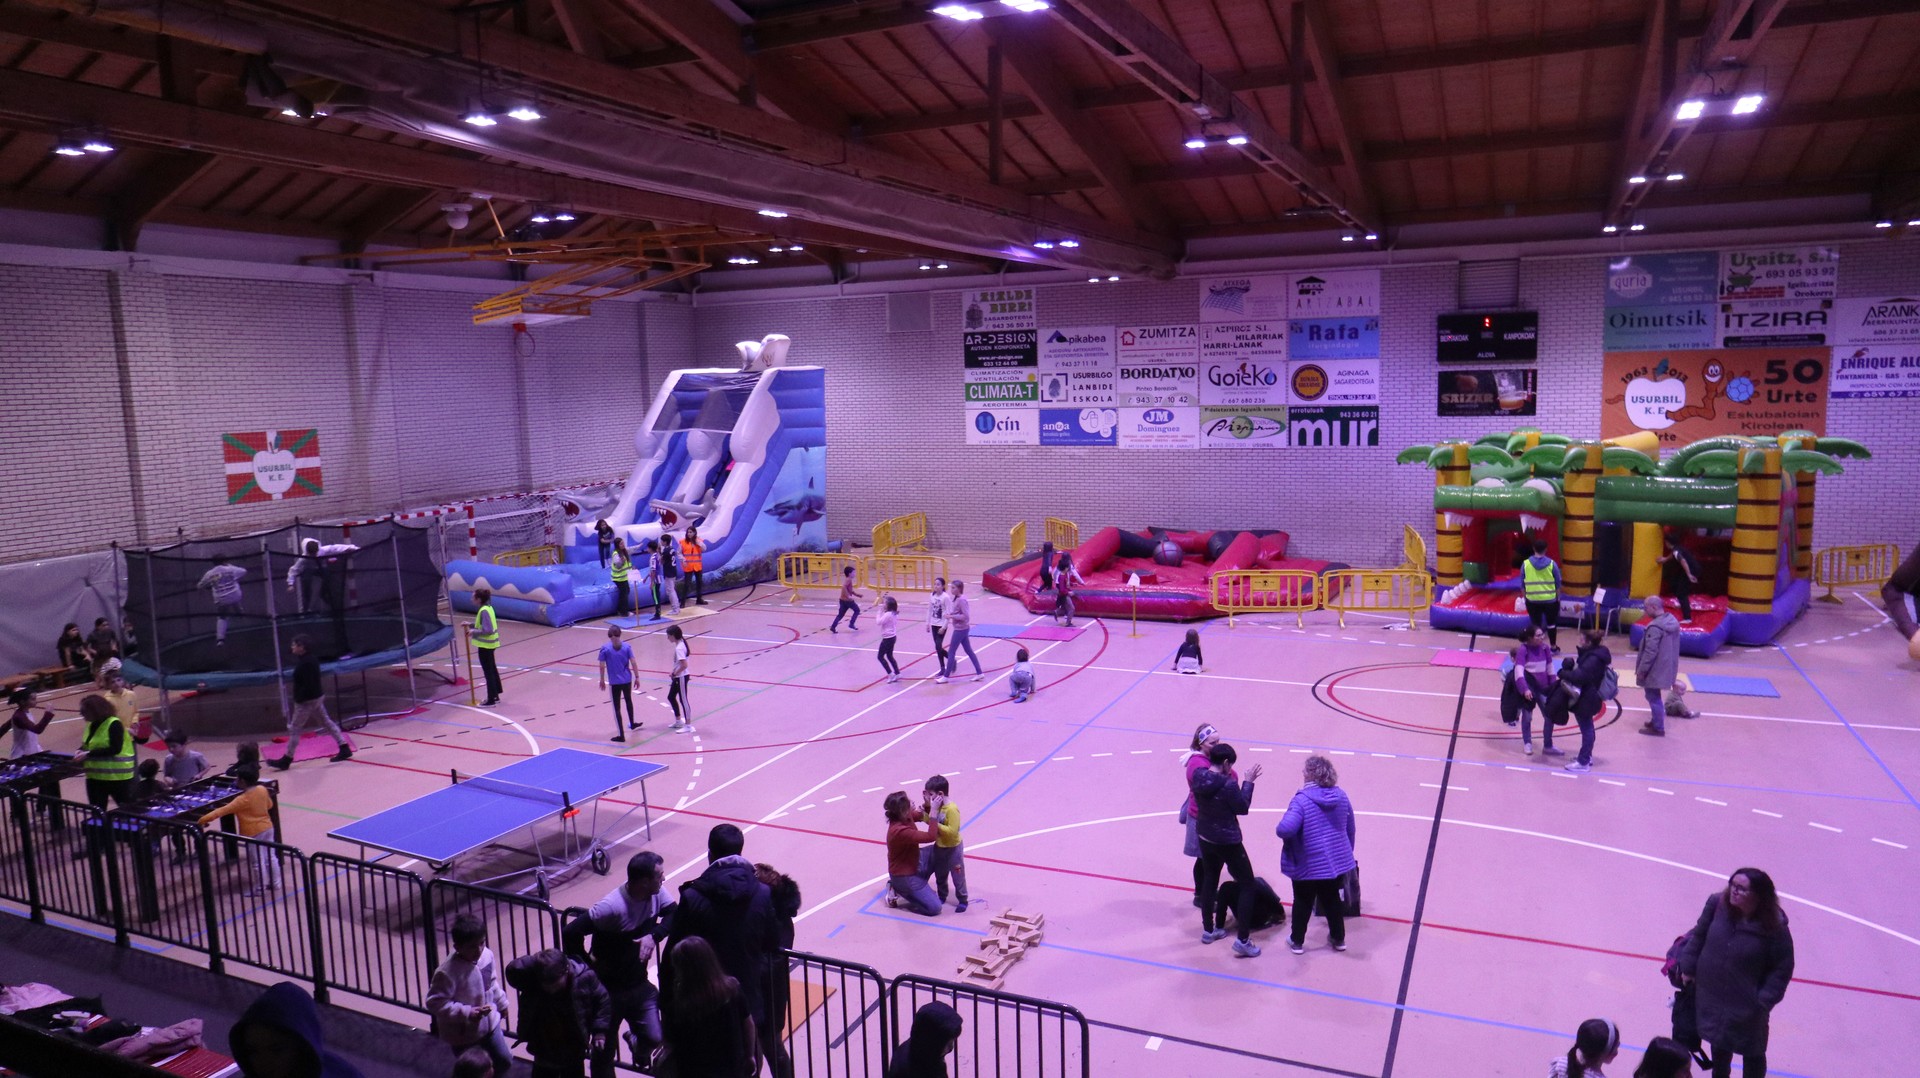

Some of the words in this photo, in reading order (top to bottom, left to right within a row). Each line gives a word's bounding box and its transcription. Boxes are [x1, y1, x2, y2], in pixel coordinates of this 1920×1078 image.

[1730, 251, 1802, 267] Uraitz,
[1766, 269, 1786, 279] 693
[1789, 269, 1802, 278] 05
[1805, 268, 1818, 276] 93
[1822, 267, 1835, 276] 92
[989, 301, 1032, 314] BERRI
[1609, 309, 1708, 329] Oinutsik
[1724, 311, 1828, 328] ITZIRA
[965, 332, 1036, 344] AR-DESIGN
[1139, 327, 1196, 338] ZUMITZA
[1235, 333, 1284, 341] HILARRIAK
[1309, 324, 1359, 341] Rafa
[1841, 357, 1896, 370] ENRIQUE
[1120, 367, 1196, 382] BORDATXO
[1208, 364, 1278, 386] Goieko
[1621, 366, 1648, 384] 1963
[1764, 359, 1823, 384] 50
[970, 384, 1034, 399] CLIMATA-T
[1767, 390, 1818, 404] Urte
[1631, 395, 1682, 404] USURBIL
[1146, 411, 1169, 423] JM
[1645, 407, 1656, 415] K.
[1728, 411, 1820, 419] Eskubaloian
[1291, 419, 1377, 446] mur
[1741, 422, 1804, 430] Kirolean
[257, 464, 294, 473] USURBIL
